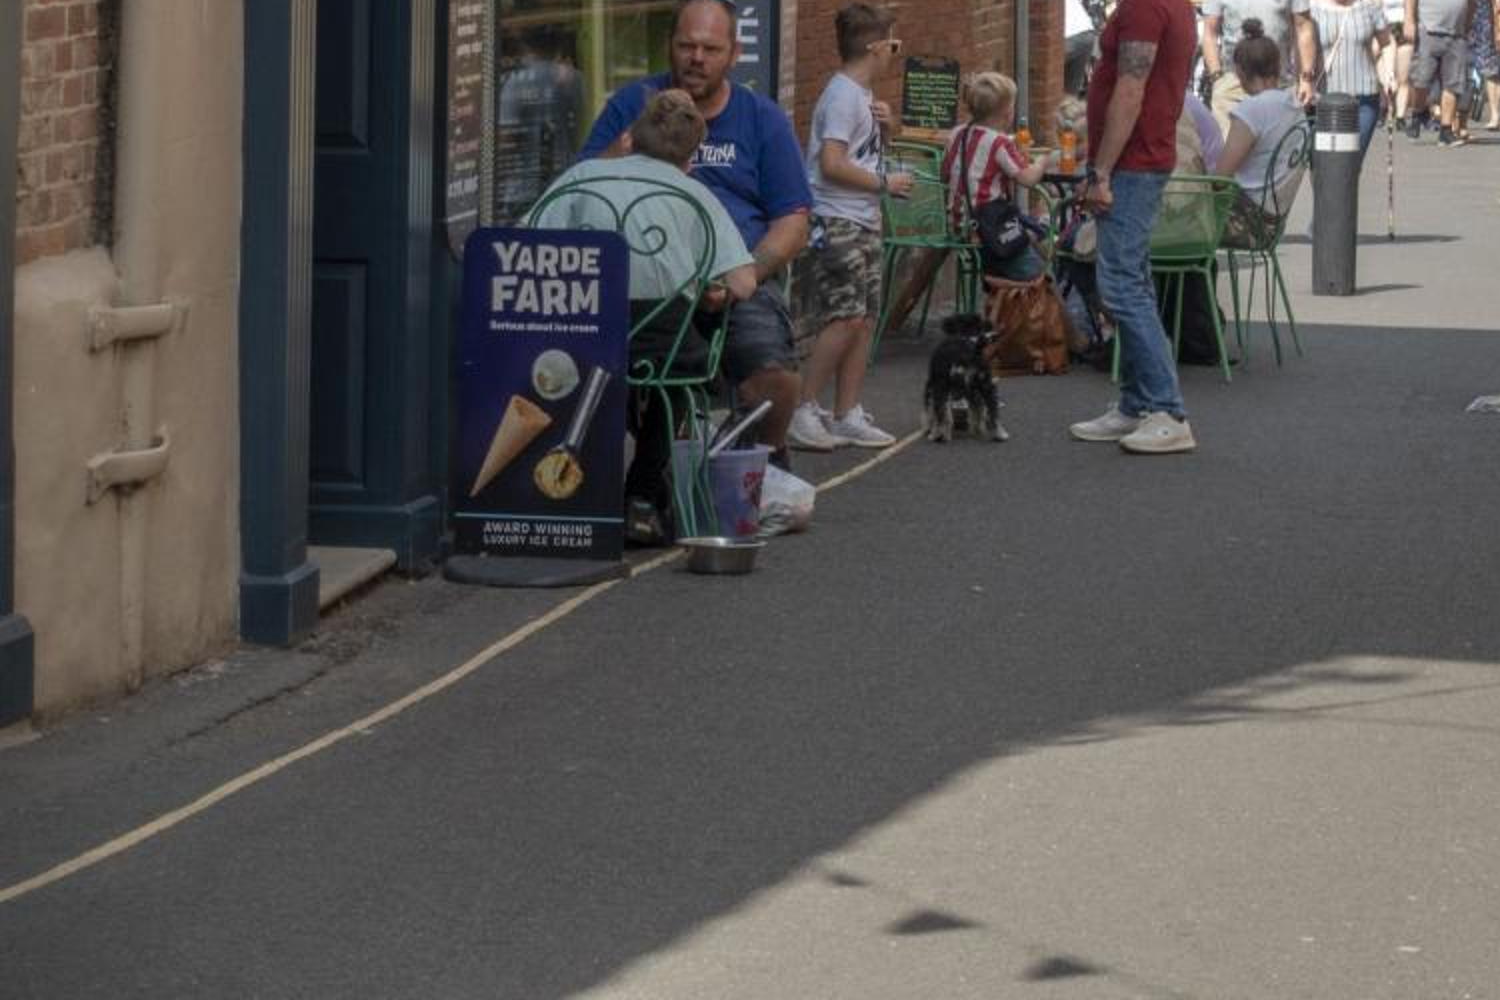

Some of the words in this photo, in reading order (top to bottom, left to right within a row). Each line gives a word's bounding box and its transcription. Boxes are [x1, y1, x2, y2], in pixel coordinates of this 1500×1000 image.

[492, 241, 601, 278] YARDE
[491, 275, 600, 315] FARM
[483, 521, 530, 535] AWARD
[535, 523, 593, 537] WINNING
[483, 534, 527, 546] LUXURY
[529, 535, 548, 546] ICE
[553, 536, 593, 548] CREAM
